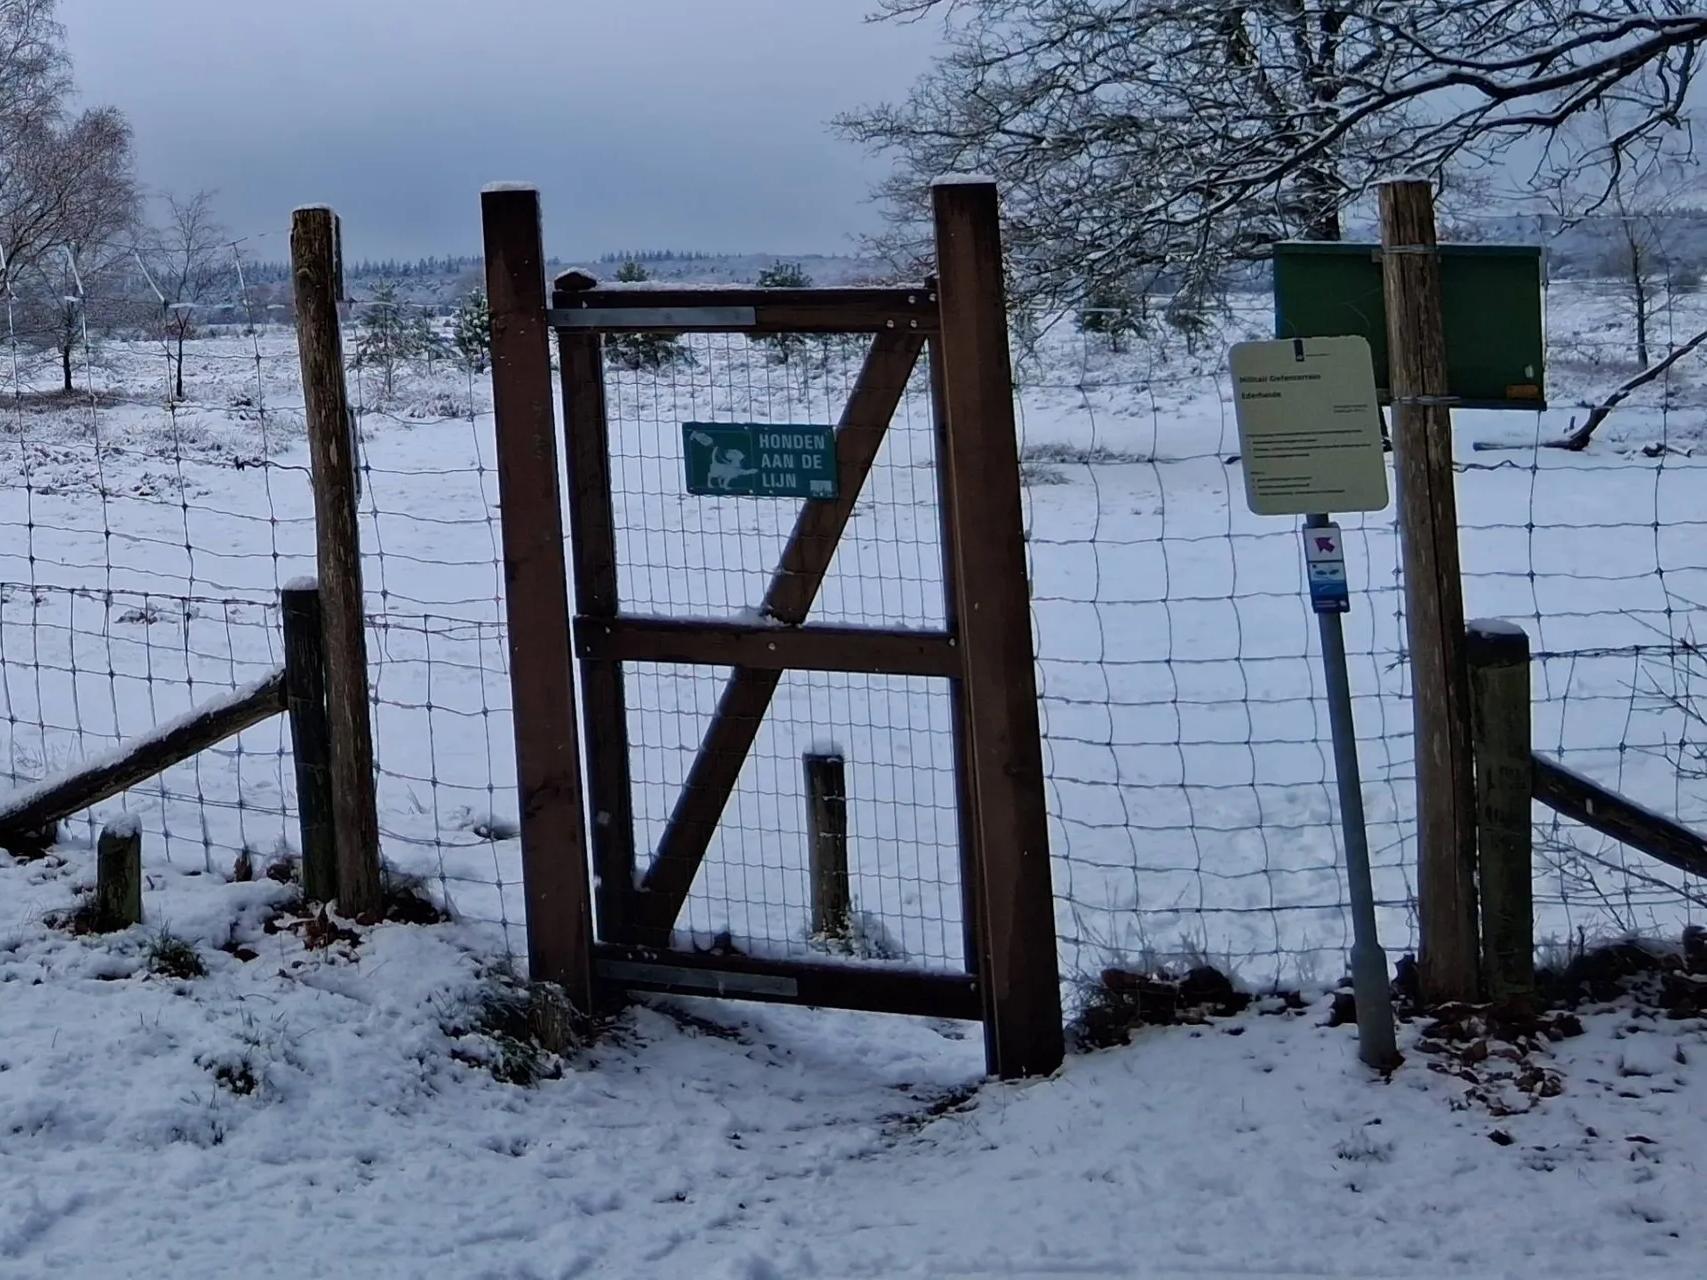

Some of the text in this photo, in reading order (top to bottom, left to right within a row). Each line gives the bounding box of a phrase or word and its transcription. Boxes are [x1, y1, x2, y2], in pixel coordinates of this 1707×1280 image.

[759, 434, 826, 450] HONDEN
[761, 454, 823, 470] AAN DE
[762, 472, 797, 489] LIJN
